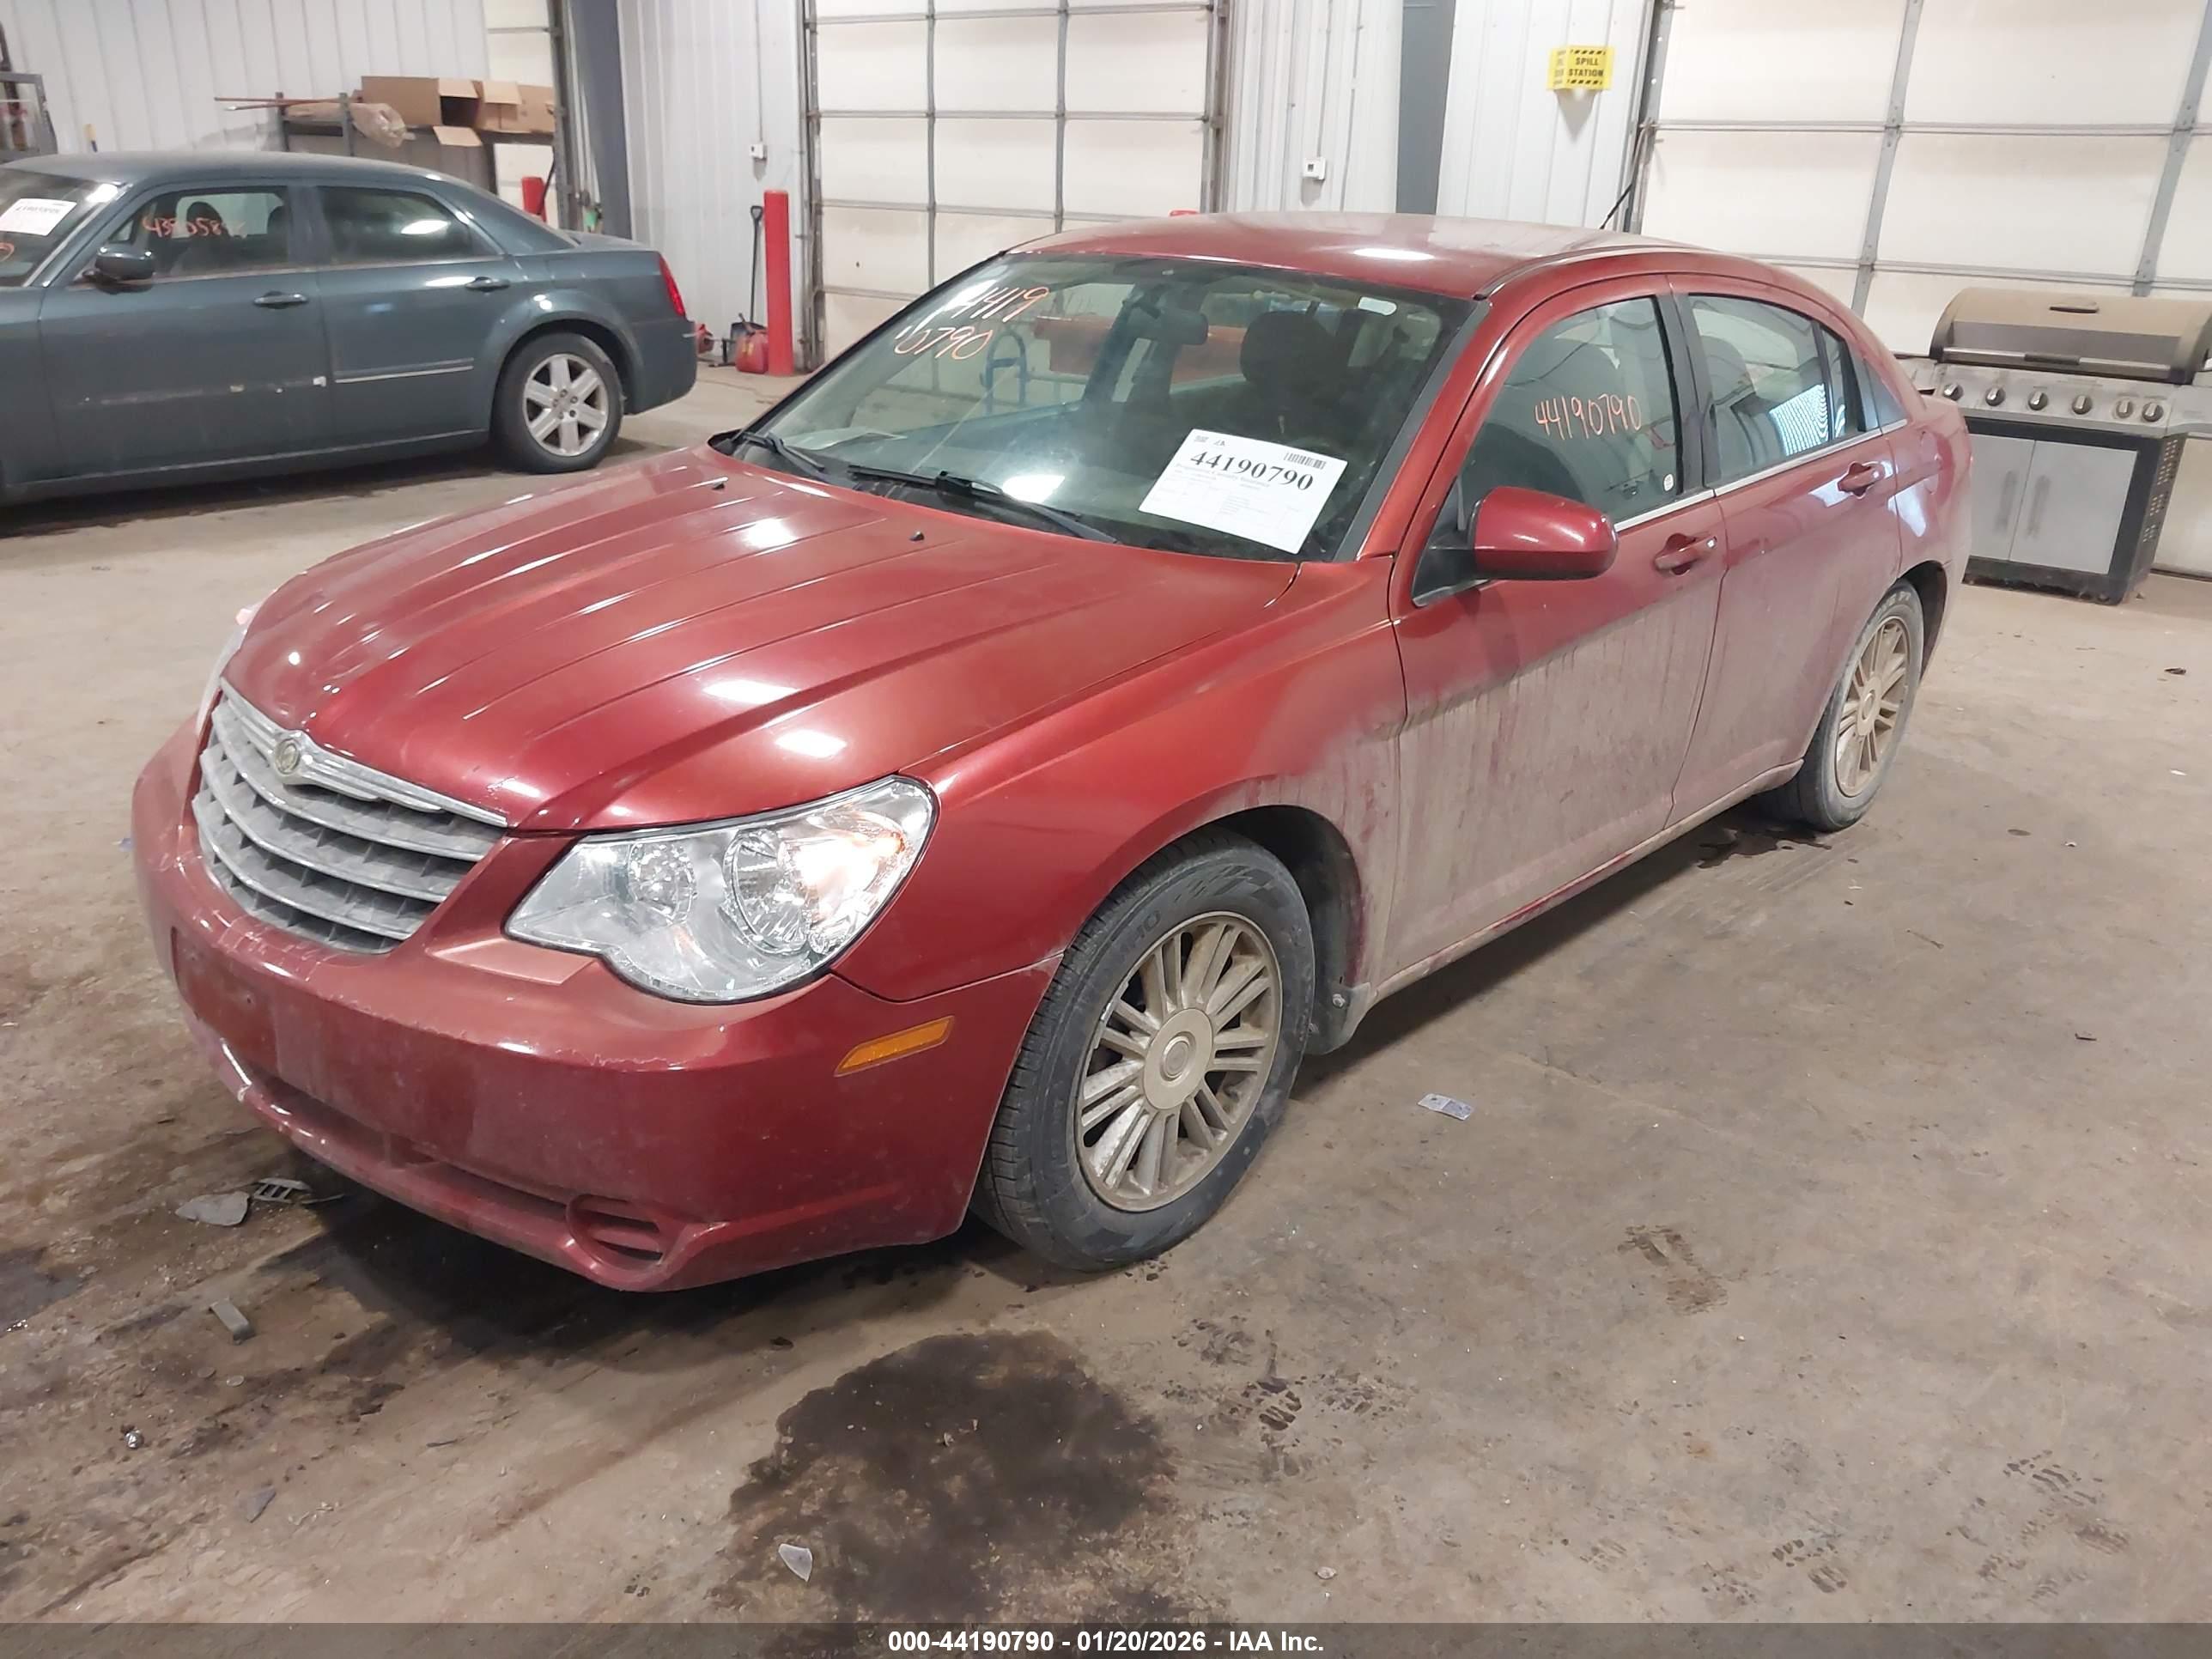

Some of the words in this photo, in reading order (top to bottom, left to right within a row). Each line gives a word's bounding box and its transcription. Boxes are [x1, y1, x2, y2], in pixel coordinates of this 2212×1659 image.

[1568, 68, 1604, 76] STATION
[1575, 57, 1599, 66] SPILL
[1534, 393, 1642, 440] 44190790
[1189, 451, 1314, 491] 44190790
